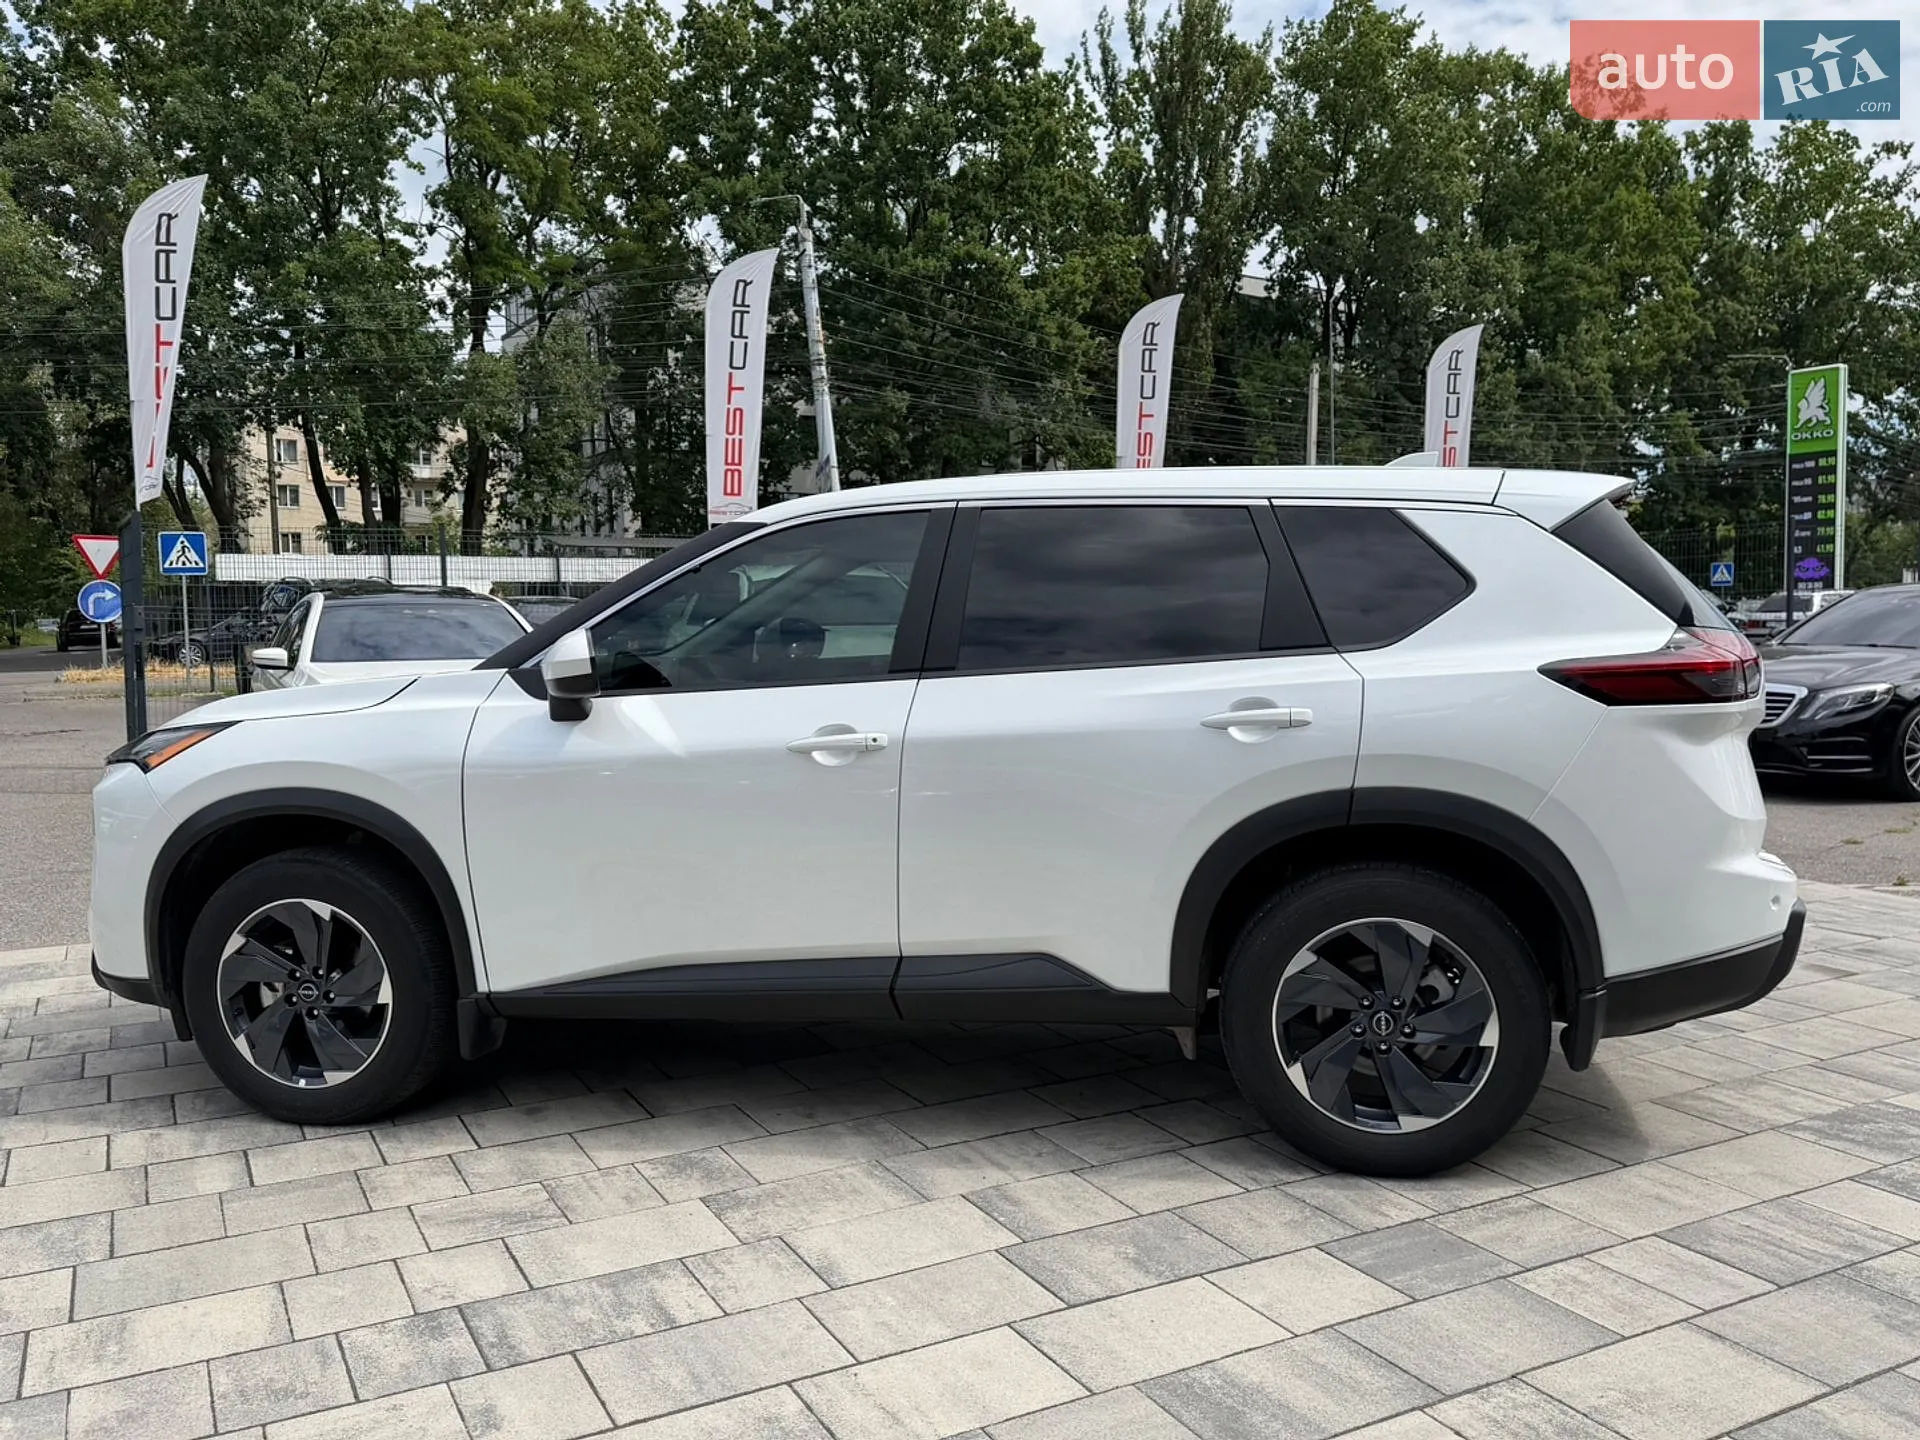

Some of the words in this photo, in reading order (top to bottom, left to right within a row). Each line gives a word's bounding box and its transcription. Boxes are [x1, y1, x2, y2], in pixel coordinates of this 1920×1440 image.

[146, 212, 178, 467] TCAR
[723, 279, 754, 496] BESTCAR
[1791, 429, 1834, 440] OKKO
